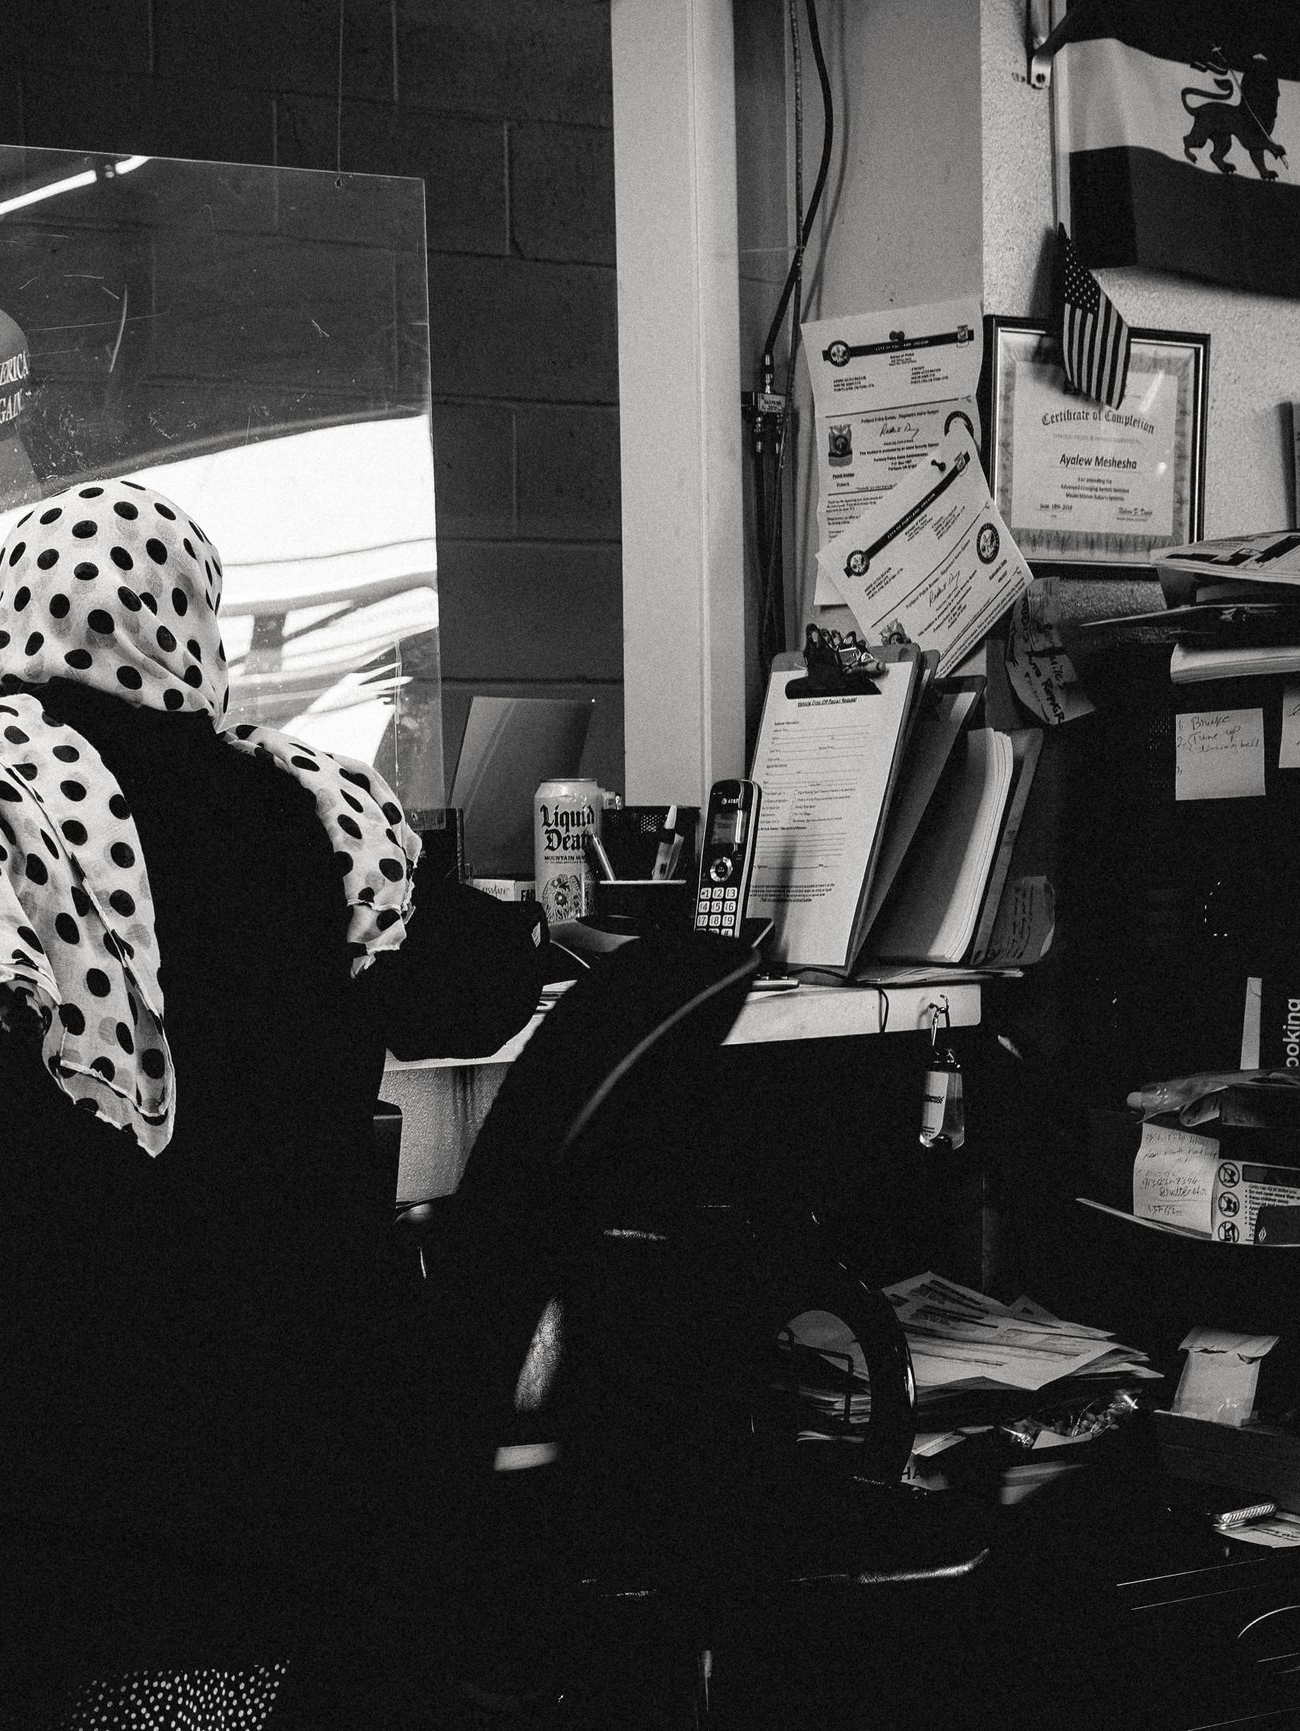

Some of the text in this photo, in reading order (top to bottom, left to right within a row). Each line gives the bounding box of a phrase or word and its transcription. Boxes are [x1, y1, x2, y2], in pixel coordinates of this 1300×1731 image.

[1042, 409, 1155, 435] Certificate of Completion
[1060, 454, 1137, 469] Ayalew Meshesha
[540, 804, 595, 835] Liquid
